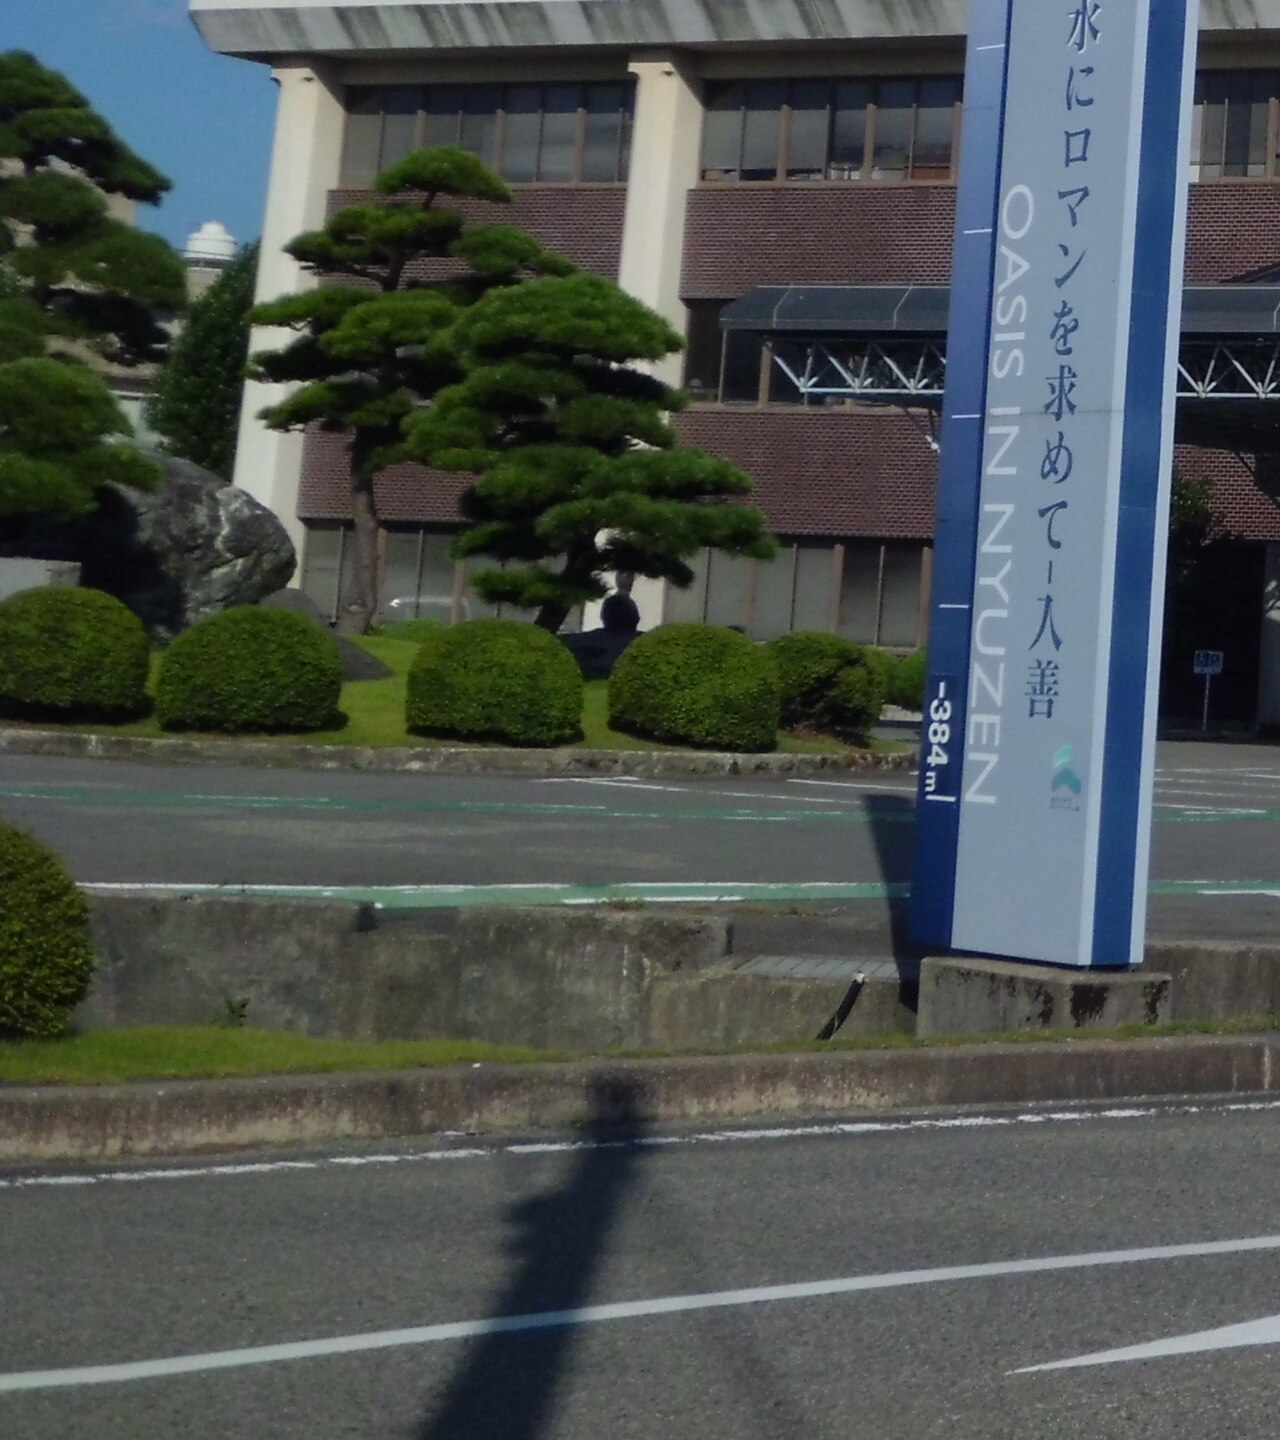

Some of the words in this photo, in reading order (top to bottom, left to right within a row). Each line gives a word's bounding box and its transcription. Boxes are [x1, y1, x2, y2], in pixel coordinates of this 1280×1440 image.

[991, 184, 1034, 380] OASIS
[986, 406, 1021, 475] IN
[964, 504, 1015, 805] NYUZEN
